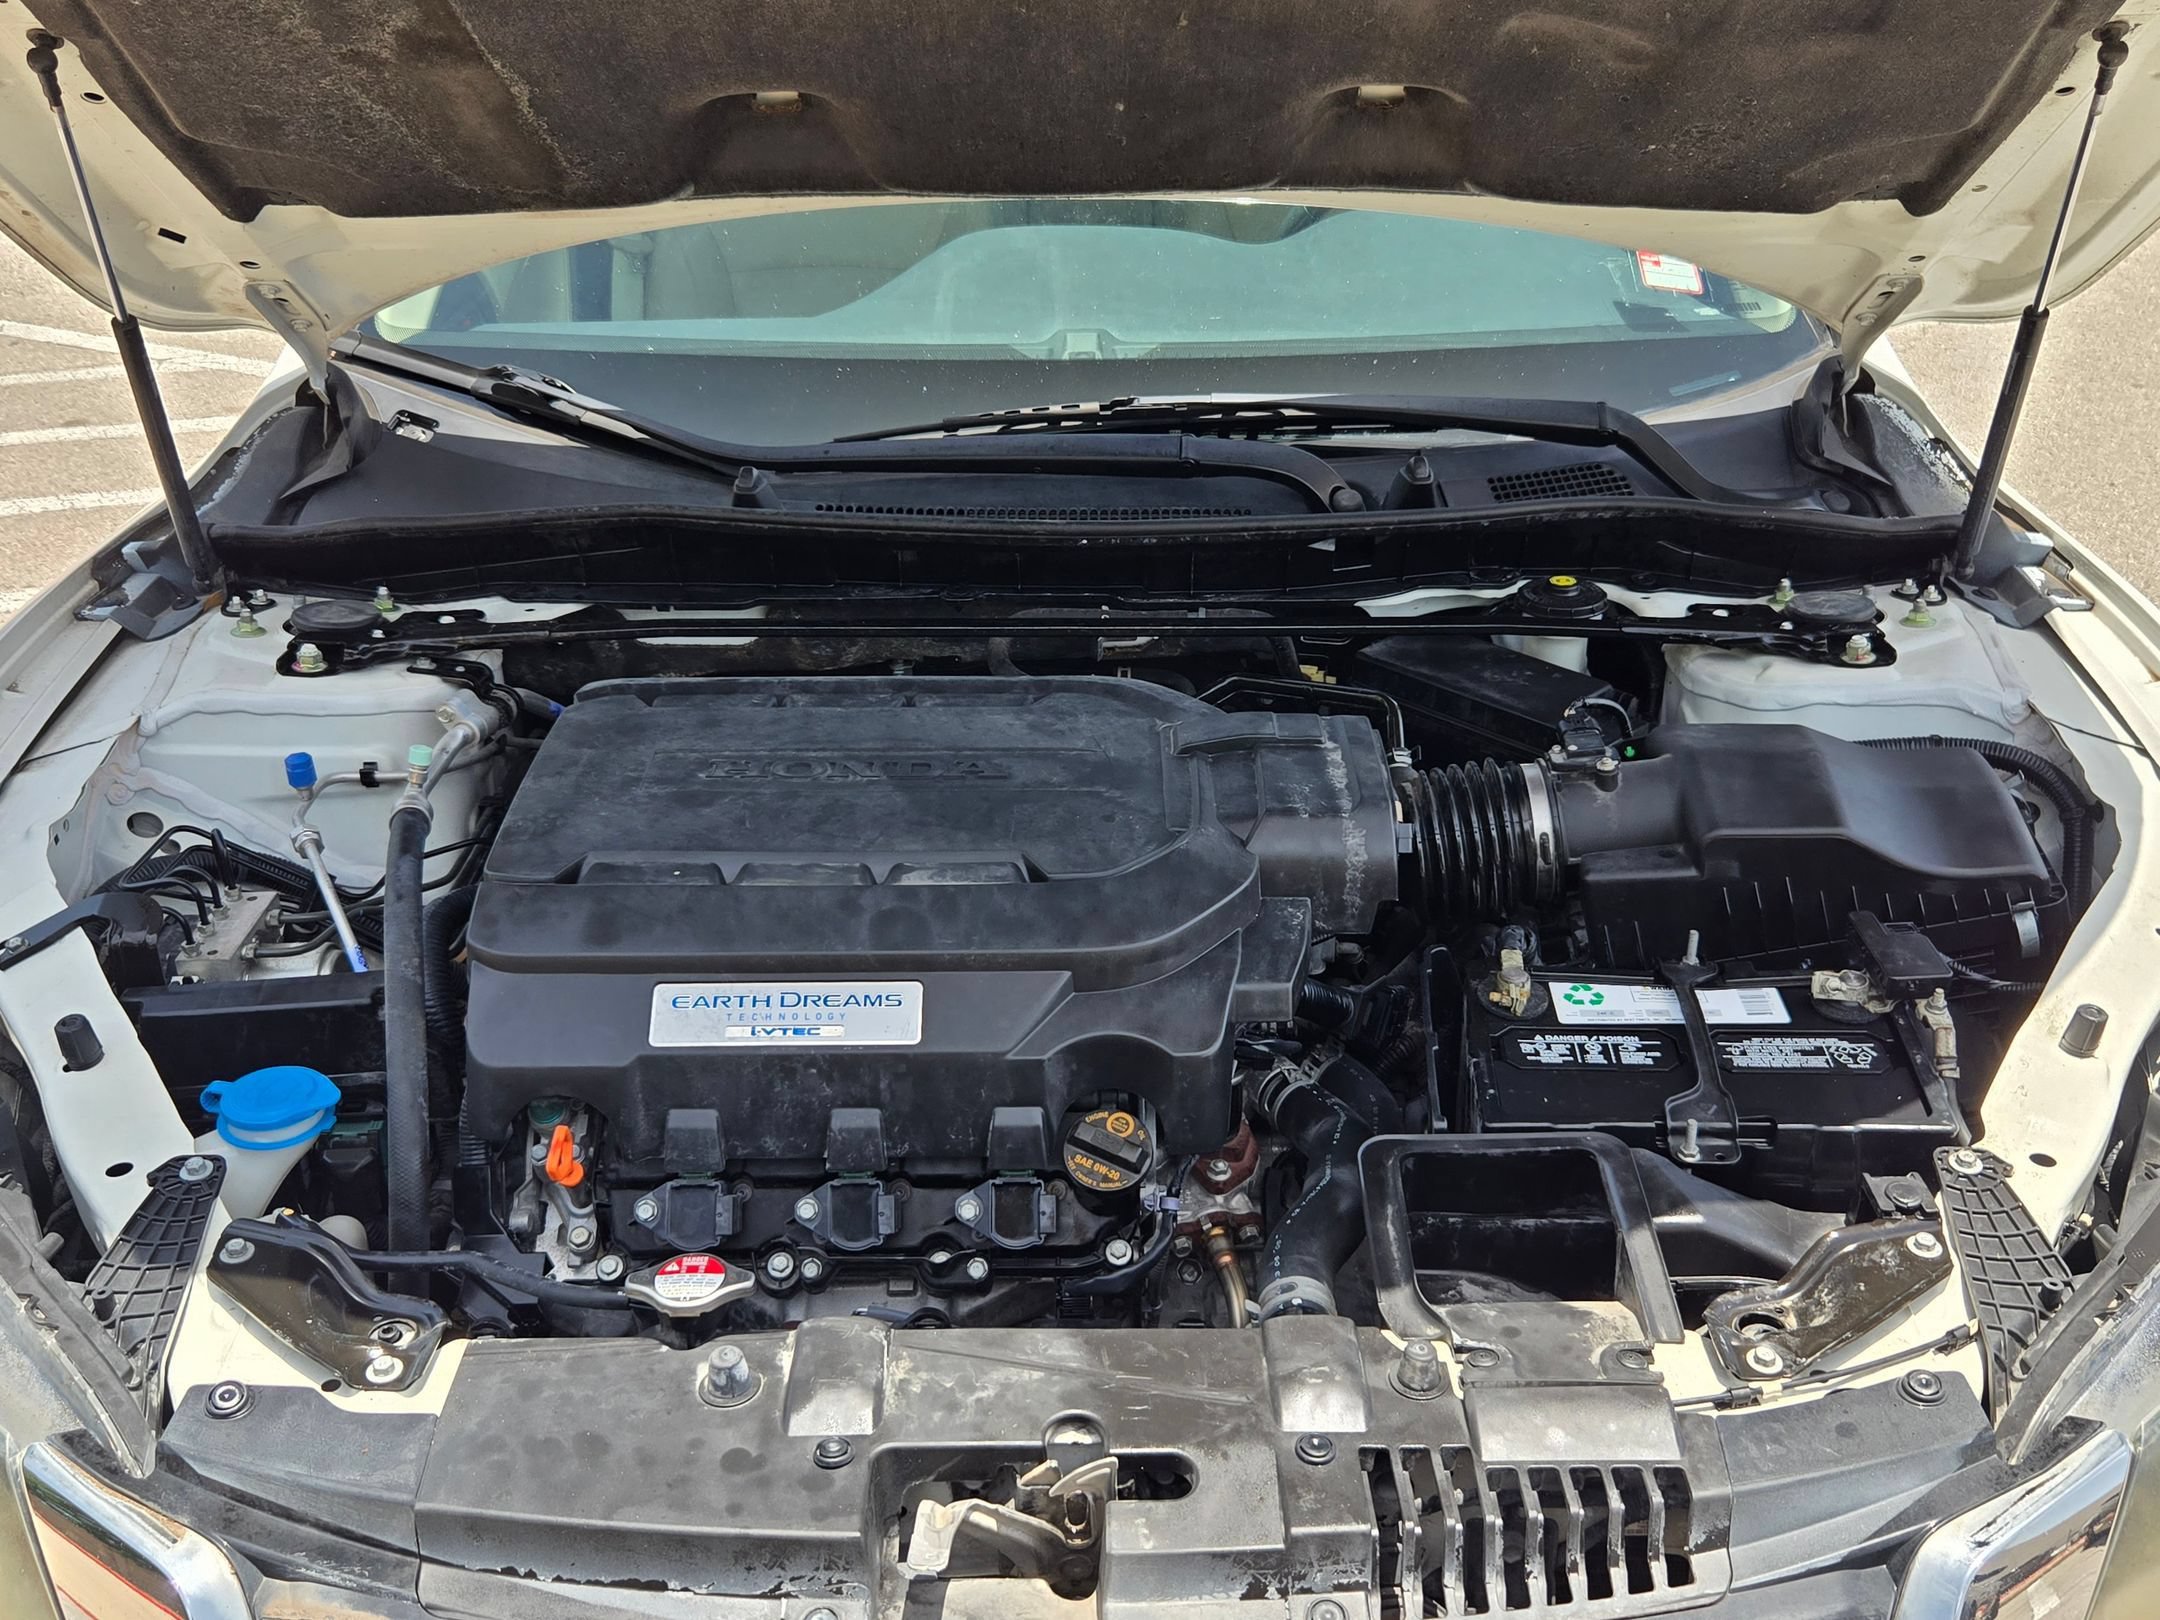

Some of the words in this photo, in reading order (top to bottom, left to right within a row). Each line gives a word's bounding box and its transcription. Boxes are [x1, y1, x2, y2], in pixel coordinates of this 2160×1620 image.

[703, 759, 1009, 780] HONDA
[671, 995, 771, 1009] EARTH
[780, 991, 902, 1008] DREAMS
[726, 1012, 847, 1022] TECHNOLOGY
[750, 1025, 822, 1037] i-VTEC
[1544, 1034, 1589, 1042] DANGER
[1599, 1035, 1640, 1043] POISON
[1074, 1154, 1094, 1169] SAE
[1094, 1163, 1120, 1180] 0W-20
